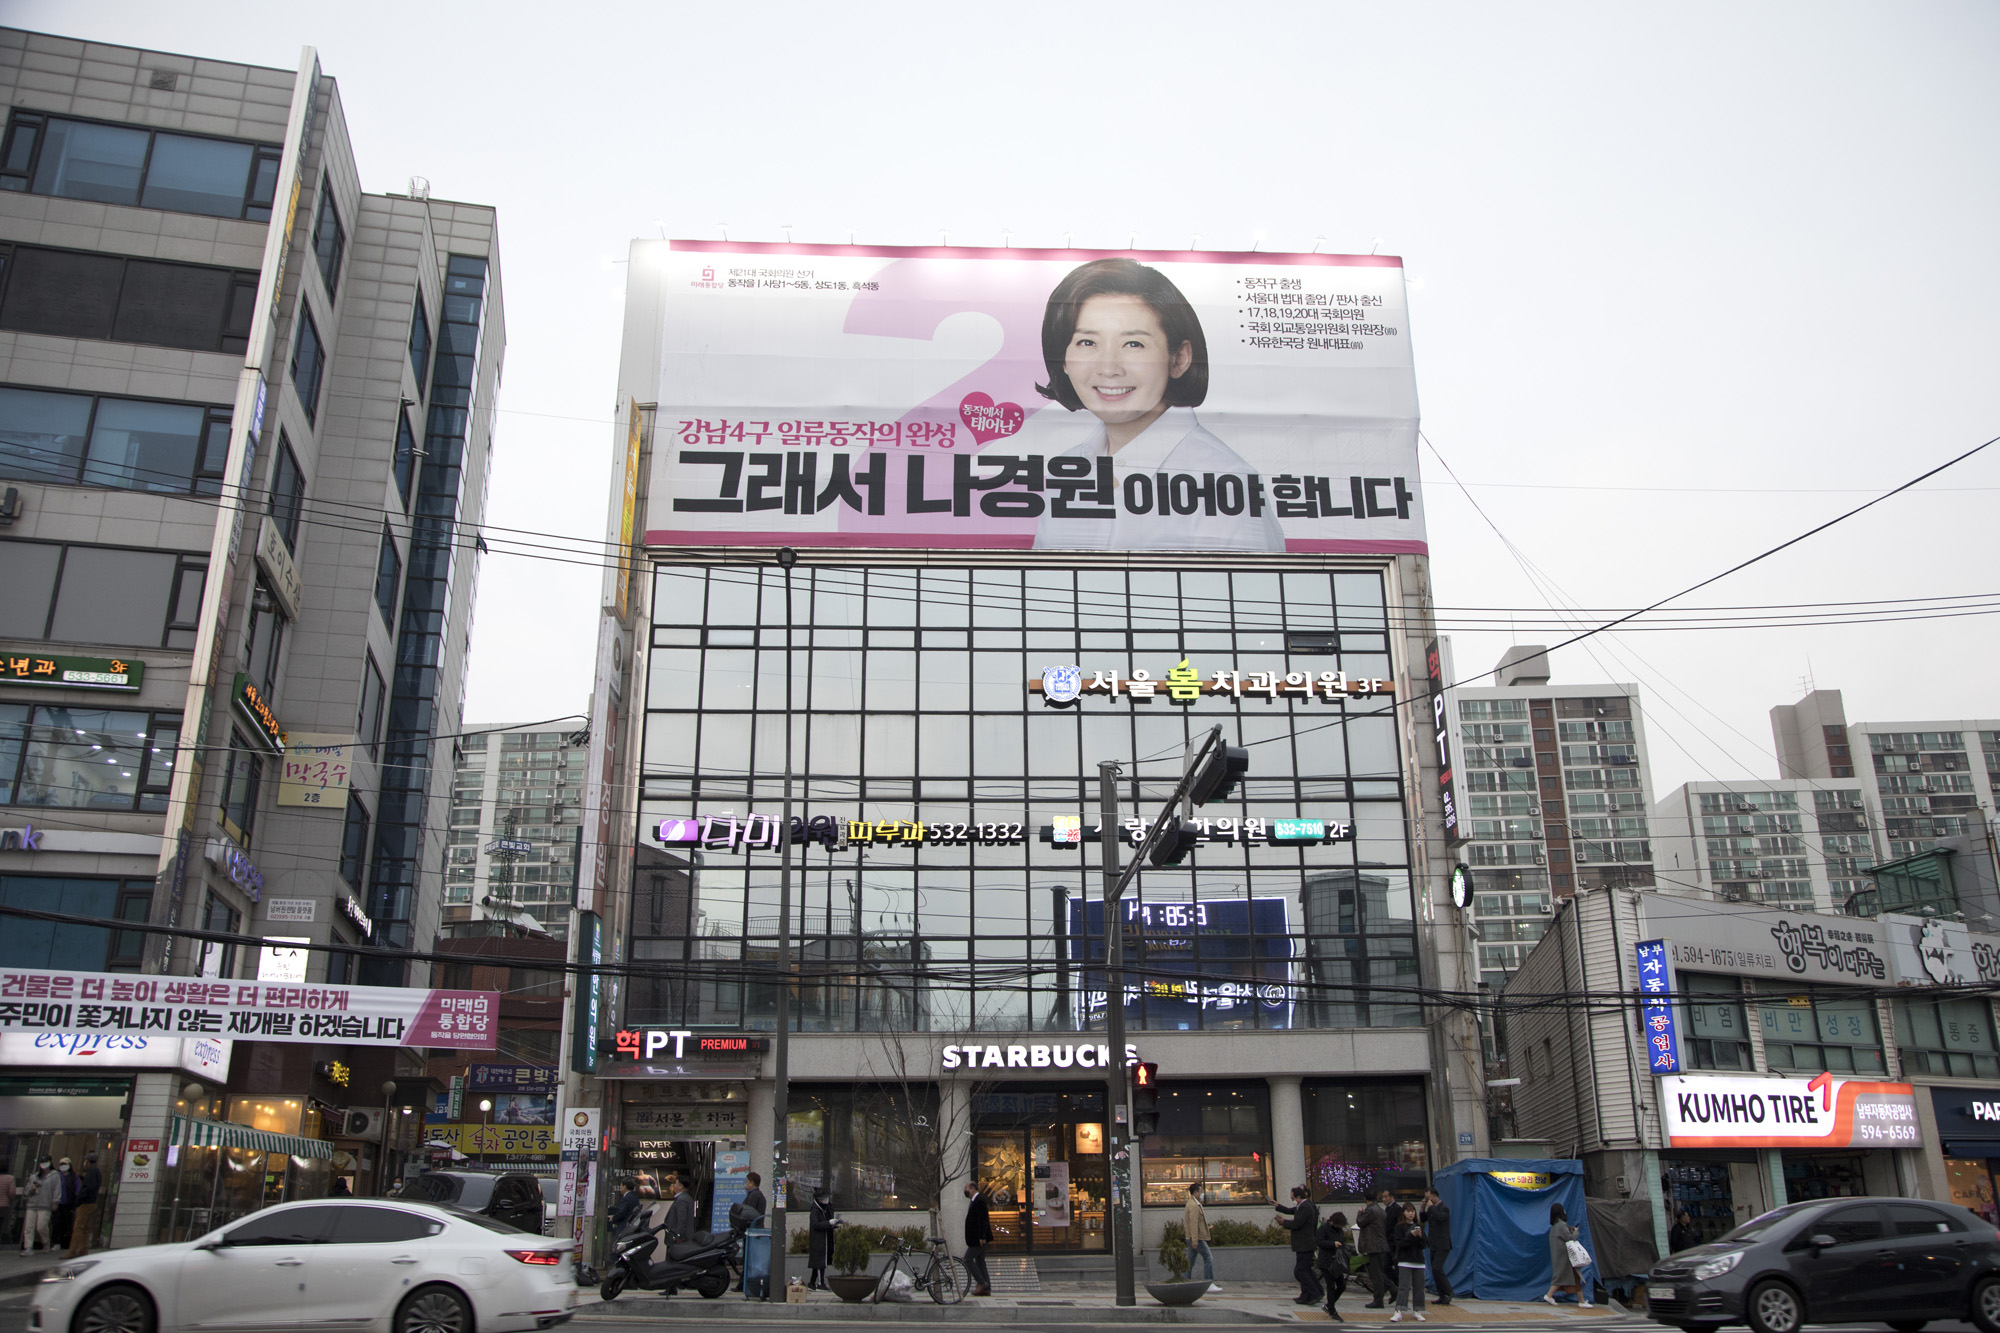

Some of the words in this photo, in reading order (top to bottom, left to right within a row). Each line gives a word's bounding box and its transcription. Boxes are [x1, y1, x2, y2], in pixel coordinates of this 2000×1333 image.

[728, 268, 757, 278] 제21대
[758, 269, 794, 279] 국회의원
[796, 270, 815, 279] 선거
[690, 281, 724, 289] 미래통합당
[728, 279, 755, 288] 동작을
[852, 281, 880, 291] 흑석동
[1244, 278, 1278, 290] 동작구
[1279, 278, 1302, 290] 출생
[1246, 292, 1278, 305] 서울대
[1280, 294, 1302, 305] 법대
[1304, 294, 1327, 306] 졸업
[1336, 294, 1359, 306] 판사
[1360, 295, 1382, 306] 출신
[1320, 308, 1365, 320] 국회의원
[1248, 322, 1271, 334] 국회
[1272, 322, 1350, 335] 외교통일위원회
[1249, 336, 1304, 349] 자유한국당
[962, 404, 1004, 418] 동작에서
[677, 418, 773, 445] 강남4구
[777, 420, 902, 447] 일류동작의
[905, 422, 956, 448] 완성
[970, 416, 1016, 436] 태어난
[673, 450, 887, 516] 그래서
[1271, 474, 1414, 520] 합니다
[0, 658, 56, 677] 년과
[110, 660, 128, 674] 3F
[1428, 650, 1441, 682] 혁
[67, 672, 125, 683] 533-5661
[1357, 678, 1383, 694] 3F
[286, 761, 348, 790] 막국수
[304, 792, 320, 803] 2층
[848, 819, 928, 842] 피부과
[930, 822, 1022, 840] 532-1332
[1276, 820, 1324, 836] 532-7510
[1329, 820, 1350, 838] 2F
[1638, 944, 1663, 958] 남부
[1771, 920, 1844, 973] 행복이
[1845, 947, 1886, 980] 머무는
[1, 974, 74, 1000] 건물은
[80, 978, 105, 1000] 더
[110, 979, 158, 1002] 높이
[164, 982, 230, 1006] 생활은
[236, 986, 258, 1008] 더
[264, 986, 350, 1011] 편리하게
[440, 998, 473, 1013] 미래
[0, 1002, 73, 1028] 주민이
[177, 1008, 223, 1033] 않는
[227, 1010, 296, 1036] 재개발
[298, 1014, 405, 1040] 하겠습니다
[438, 1012, 490, 1032] 통합당
[1643, 959, 1676, 1070] 자동차공업사
[1765, 1010, 1802, 1034] 비만
[1826, 1014, 1862, 1036] 성장
[34, 1032, 151, 1056] express
[194, 1040, 221, 1065] express
[700, 1038, 747, 1050] PREMIUM
[1678, 1092, 1766, 1124] KUMHO
[1768, 1094, 1818, 1124] TIRE
[1856, 1103, 1913, 1120] 남부자동차공업사
[502, 1128, 557, 1150] 공인중
[569, 1128, 592, 1136] 국회의원
[1860, 1124, 1916, 1140] 594-6569
[564, 1138, 596, 1149] 나경원
[563, 1171, 574, 1206] 피부과
